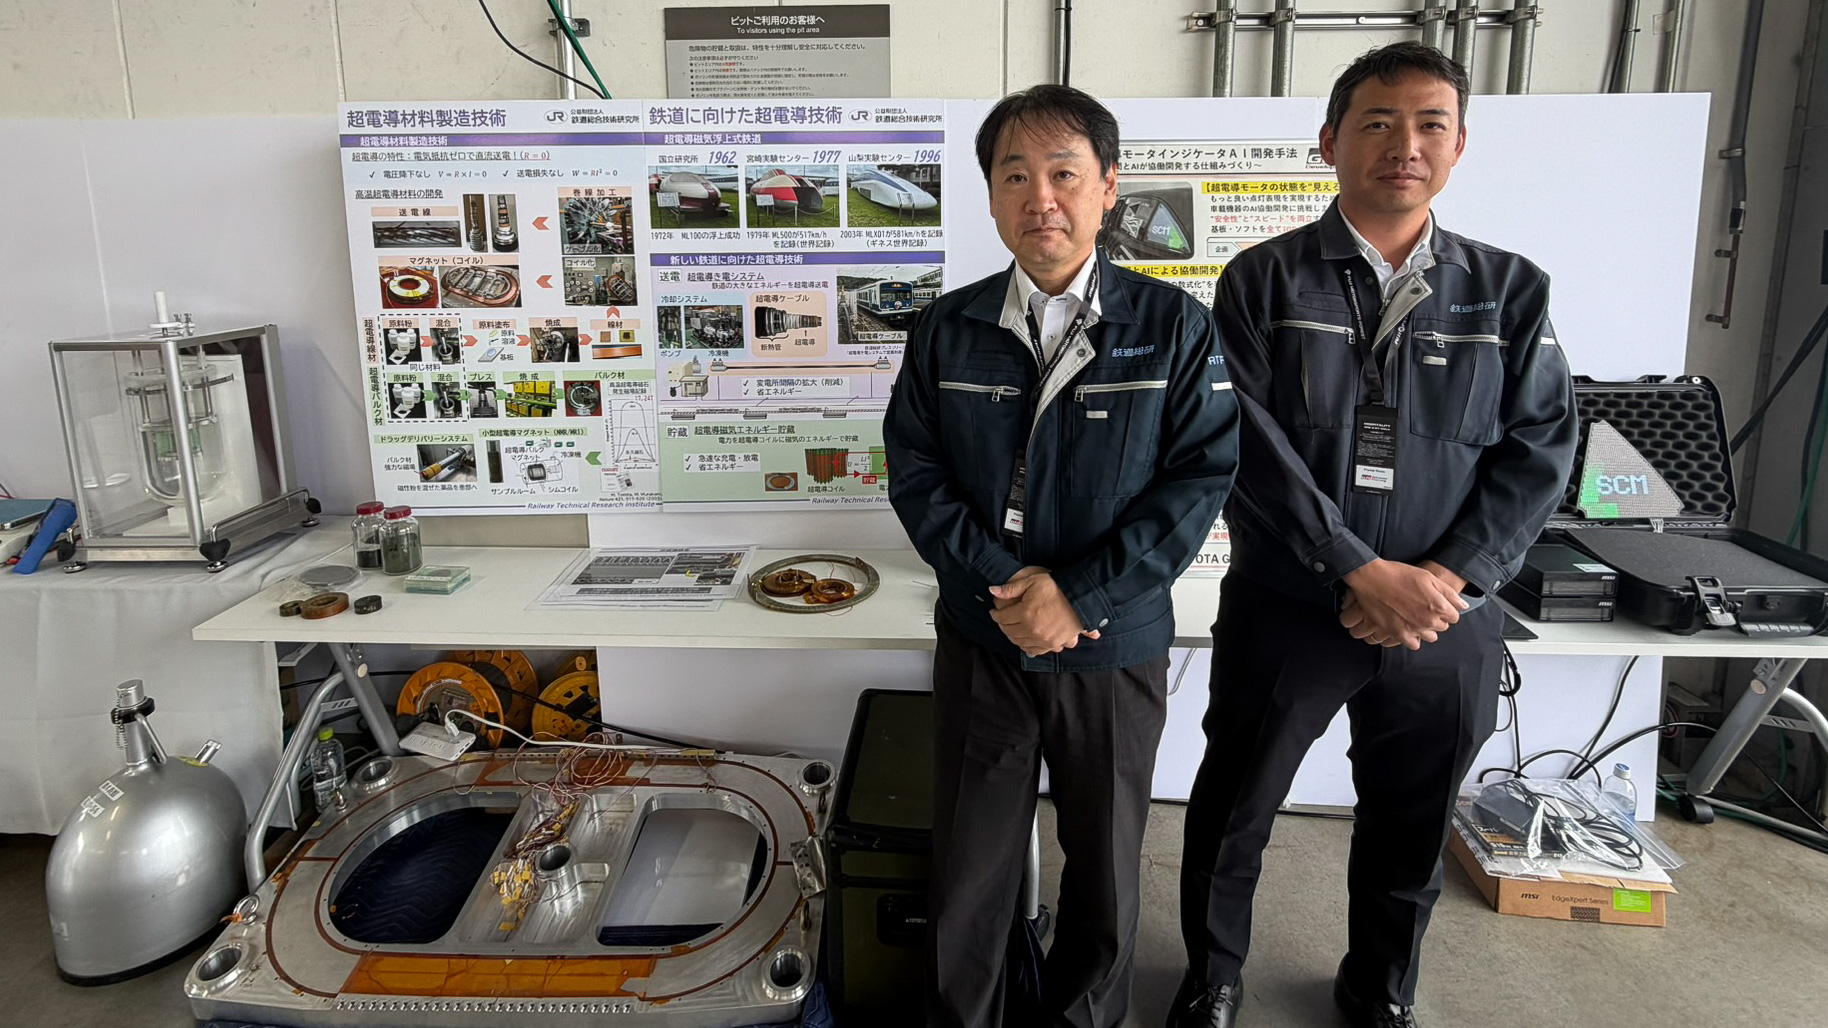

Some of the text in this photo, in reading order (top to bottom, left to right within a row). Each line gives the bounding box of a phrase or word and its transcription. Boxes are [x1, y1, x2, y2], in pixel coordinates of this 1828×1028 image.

[730, 16, 825, 26] ピットご利用のお客様へ
[346, 110, 506, 128] 超電導材料製造技術
[546, 112, 564, 122] JR
[572, 116, 640, 124] 鉄道総合技術研究所
[648, 106, 842, 126] 鉄道に向けた超電導技術
[851, 110, 869, 122] JR
[874, 114, 942, 123] 鉄道総合技術研究所
[360, 136, 448, 146] 超電導材料製造技術
[664, 134, 762, 144] 超電導磁気浮上式鉄道
[658, 151, 736, 164] 国立研究所 1962
[746, 150, 841, 164] 宮崎実験センター 1977
[848, 150, 941, 163] 山梨実験センター 1996
[1119, 148, 1298, 159] モータインジケータAI開発手法
[384, 170, 430, 179] 電圧降下なし
[516, 169, 564, 178] 送電損失なし
[355, 189, 443, 199] 高温超電導材料の開発
[651, 232, 674, 240] 1972年
[747, 231, 770, 239] 1979年
[840, 230, 864, 238] 2003年
[670, 254, 804, 266] 新しい鉄道に向けた超電導技術
[660, 272, 764, 282] 送電 超電導き電システム
[712, 281, 829, 290] 鉄道の大きなエネルギーを超電導送電
[661, 295, 708, 304] 冷却システム
[756, 294, 810, 303] 超電導ケーブル
[436, 319, 451, 327] 混合
[478, 321, 510, 329] 原料塗布
[545, 319, 561, 327] 焼成
[607, 321, 623, 329] 線材
[795, 338, 815, 346] 超電導
[660, 350, 681, 358] ポンプ
[394, 374, 417, 382] 原料粉
[438, 374, 453, 382] 混合
[470, 373, 492, 381] プレス
[757, 388, 802, 396] 省エネルギー
[667, 425, 795, 437] 貯蔵 超電導磁気エネルギー貯蔵
[380, 435, 468, 443] ドラッグデリバリーシステム
[718, 435, 858, 444] 電力を超電導コイルに磁気のエネルギーで貯蔵
[699, 463, 744, 471] 省エネルギー
[807, 485, 845, 493] 超電導コイル
[1596, 474, 1650, 496] SCM
[812, 497, 838, 505] Railway
[528, 502, 554, 510] Railway
[1196, 554, 1219, 564] OTA
[1552, 895, 1588, 903] EdgeXpert
